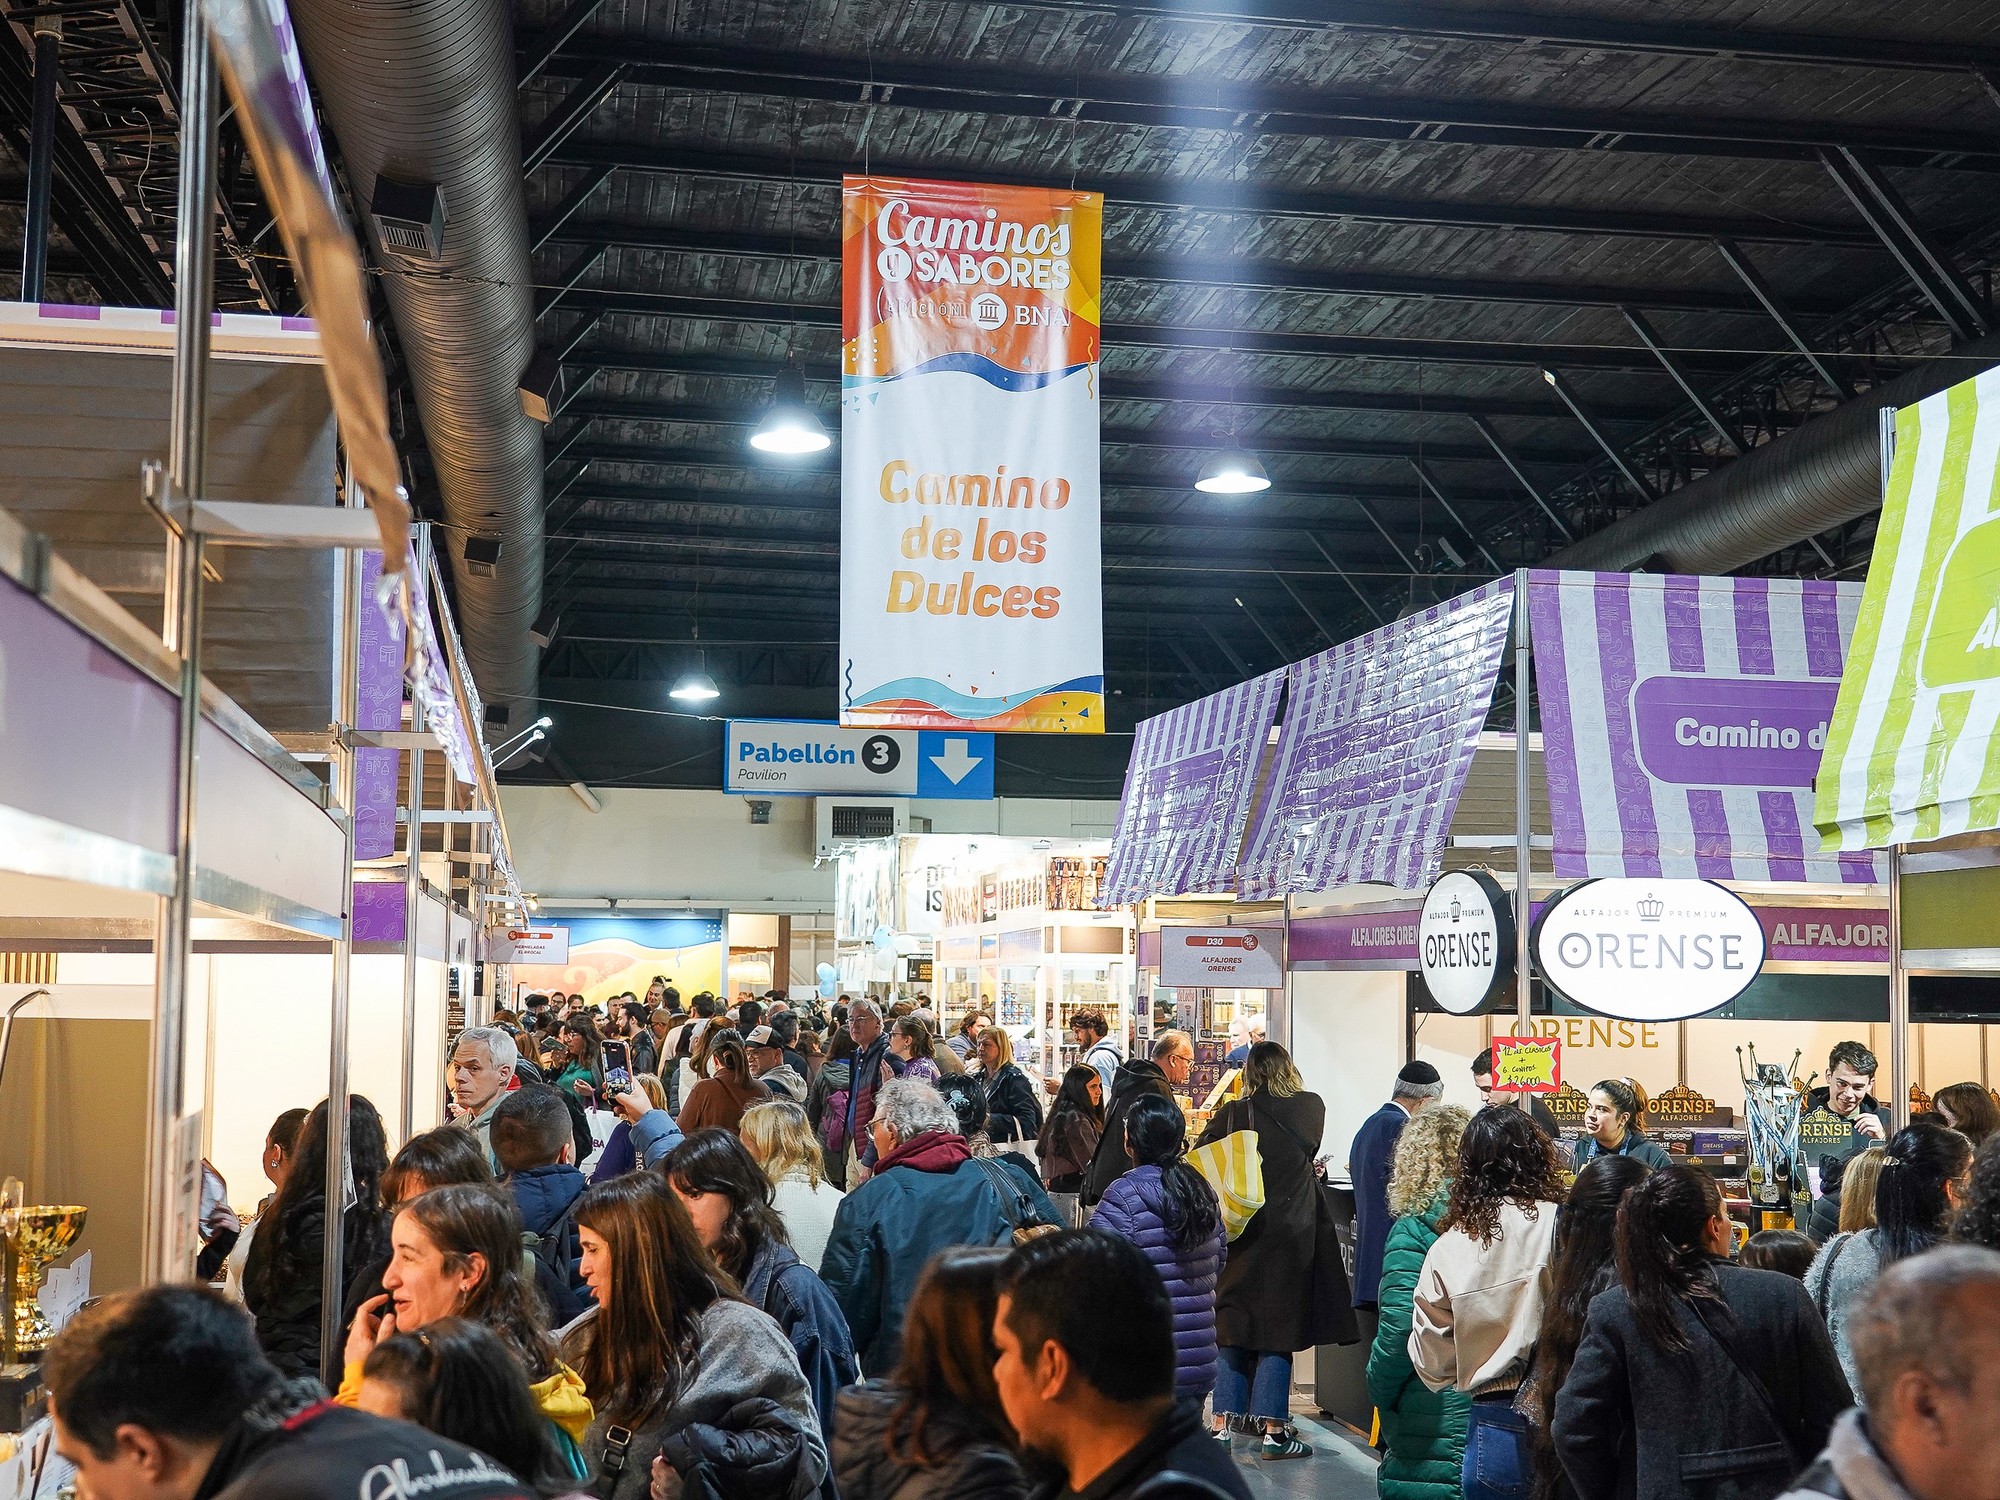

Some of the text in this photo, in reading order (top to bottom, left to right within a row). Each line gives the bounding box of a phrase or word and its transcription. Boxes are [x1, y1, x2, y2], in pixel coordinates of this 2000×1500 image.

[877, 199, 1070, 256] Caminos
[916, 251, 1071, 290] SABORES
[879, 459, 1071, 510] Camino
[901, 514, 1048, 564] de los
[886, 570, 1062, 619] Dulces
[1675, 717, 1800, 750] Camino
[739, 741, 891, 765] Pabellón 3
[737, 769, 787, 781] Pavilion
[1429, 909, 1485, 919] ALFAJOR PREMIUM
[1573, 909, 1728, 918] ALFAJOR PREMIUM
[1206, 937, 1224, 946] D30
[1350, 927, 1396, 947] ALFAJORES
[1771, 922, 1889, 947] ALFAJOR
[1425, 931, 1492, 969] ORENSE
[1558, 932, 1744, 970] ORENSE
[1648, 1099, 1714, 1113] ORENSE
